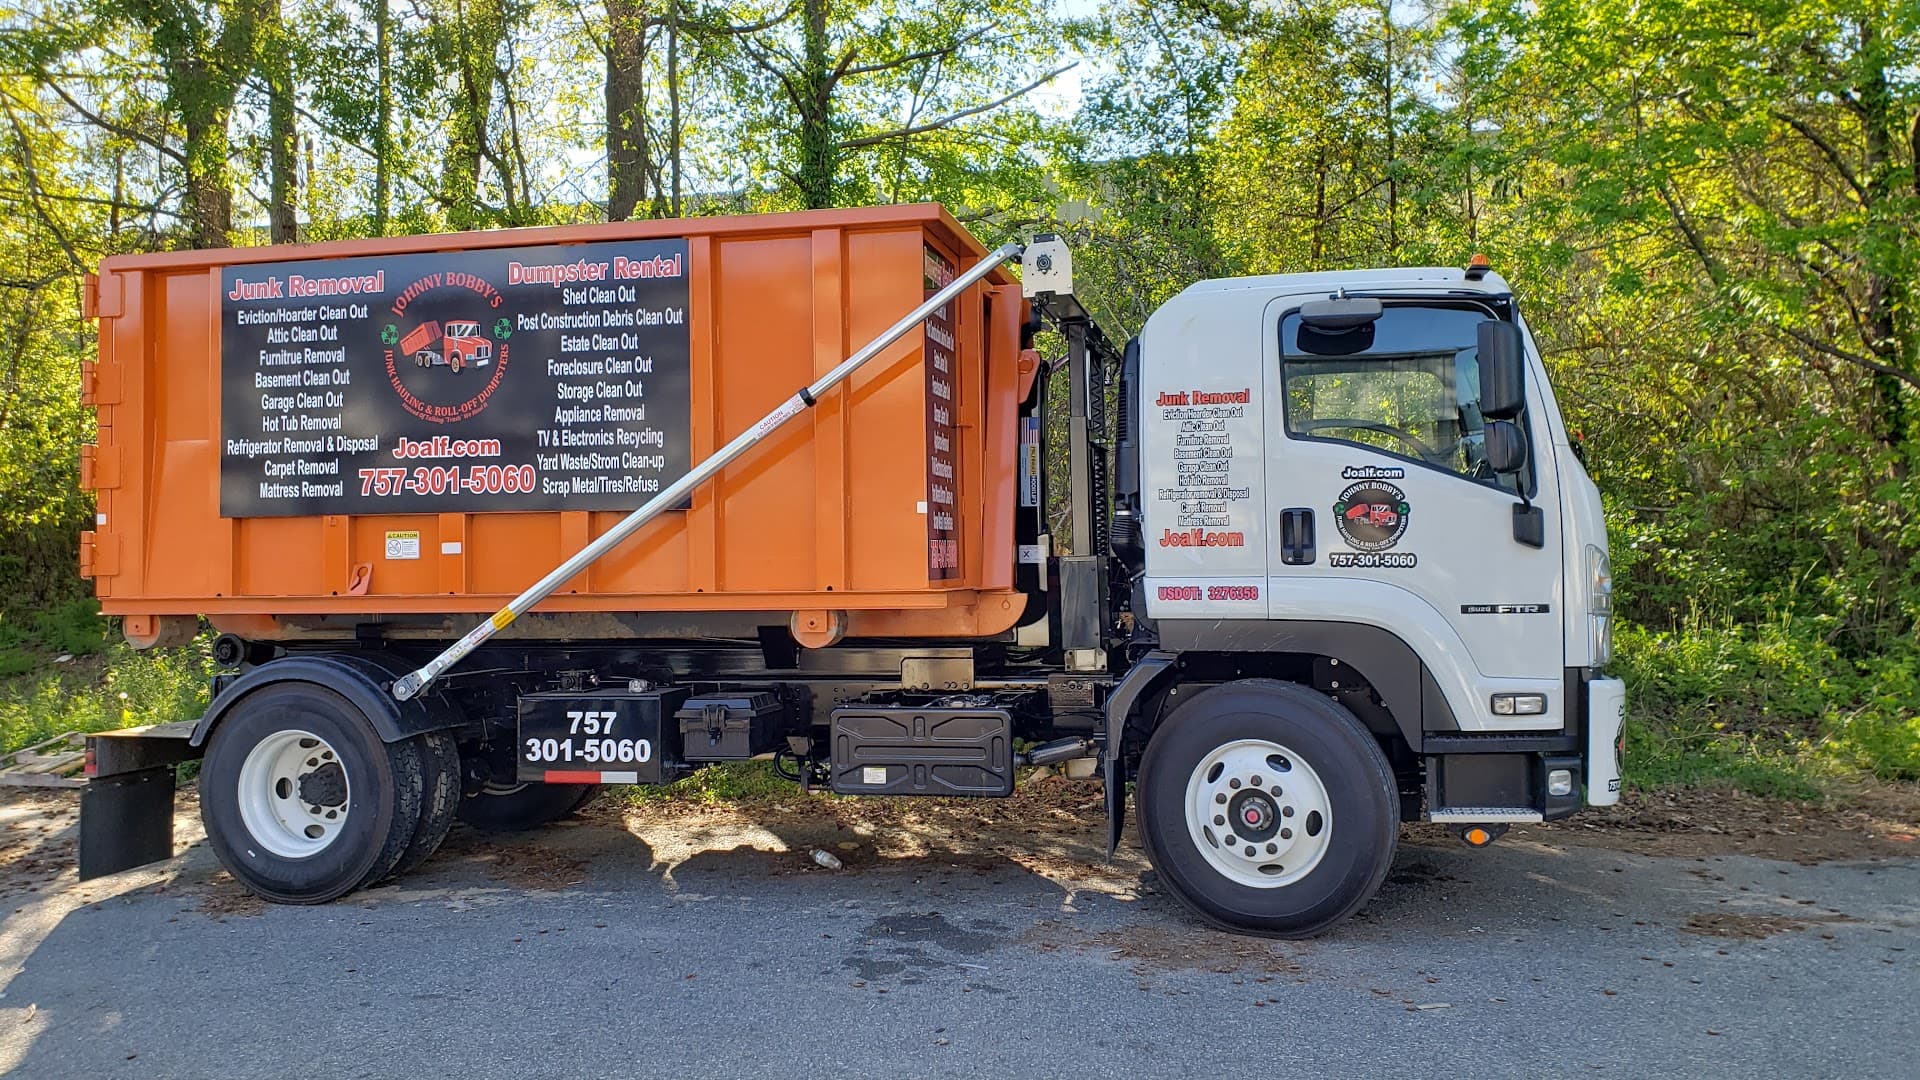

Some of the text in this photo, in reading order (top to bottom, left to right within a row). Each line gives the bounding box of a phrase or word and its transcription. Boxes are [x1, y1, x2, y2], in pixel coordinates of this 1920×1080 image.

[508, 253, 681, 288] Dumpster Rental
[229, 271, 384, 300] Junk Removal
[392, 272, 503, 318] JOHNNY BOBBY'S
[563, 285, 635, 305] Shed Clean Out
[238, 304, 368, 325] Eviction/Hoarder Clean Out
[517, 307, 683, 330] Post Construction Debris Clean Out
[267, 325, 338, 343] Attic Clean Out
[561, 333, 638, 352] Estate Clean Out
[304, 347, 345, 365] Removal
[547, 356, 653, 376] Foreclosure Clean Out
[255, 369, 350, 389] Basement Clean Out
[384, 344, 509, 417] JUNK HAULING & ROLL-OFF DUMPSTERS
[557, 380, 643, 402] Storage Clean Out
[1156, 388, 1250, 406] Junk Removal
[261, 392, 343, 412] Garage Clean Out
[1212, 407, 1230, 418] Clean
[1231, 406, 1243, 418] Out
[262, 414, 341, 432] Hot Tub Removal
[555, 404, 645, 426] Appliance Removal
[760, 411, 783, 430] CAUTION
[1196, 420, 1213, 431] Clean
[1213, 420, 1225, 431] Out
[227, 435, 379, 458] Refrigerator Removal & Disposal
[392, 436, 501, 459] Joalf.com
[537, 427, 664, 449] TV & Electronics Recycling
[1204, 433, 1230, 445] Removal
[537, 453, 558, 471] Yard
[622, 452, 665, 472] Clean-up
[1174, 447, 1233, 460] Basement Clean Out
[264, 459, 339, 479] Carpet Removal
[1178, 460, 1229, 474] Garage Clean Out
[1342, 467, 1404, 478] Joalf.com
[260, 481, 343, 498] Mattress Removal
[359, 464, 536, 496] 757-301-5060
[543, 476, 659, 497] Scrap Metal/Tires/Refuse
[1179, 474, 1228, 486] Hot Tub Removal
[1217, 488, 1223, 499] &
[1223, 487, 1250, 501] Disposal
[1341, 482, 1404, 502] JOHNNY BOBBY'S
[1200, 501, 1227, 513] Removal
[1204, 514, 1230, 526] Removal
[1159, 528, 1244, 547] Joalf.com
[1330, 554, 1416, 567] 757-301-5060
[1158, 586, 1258, 600] USDOT: 3276358
[1498, 605, 1539, 613] FTR
[567, 711, 617, 735] 757
[525, 738, 651, 763] 301-5060
